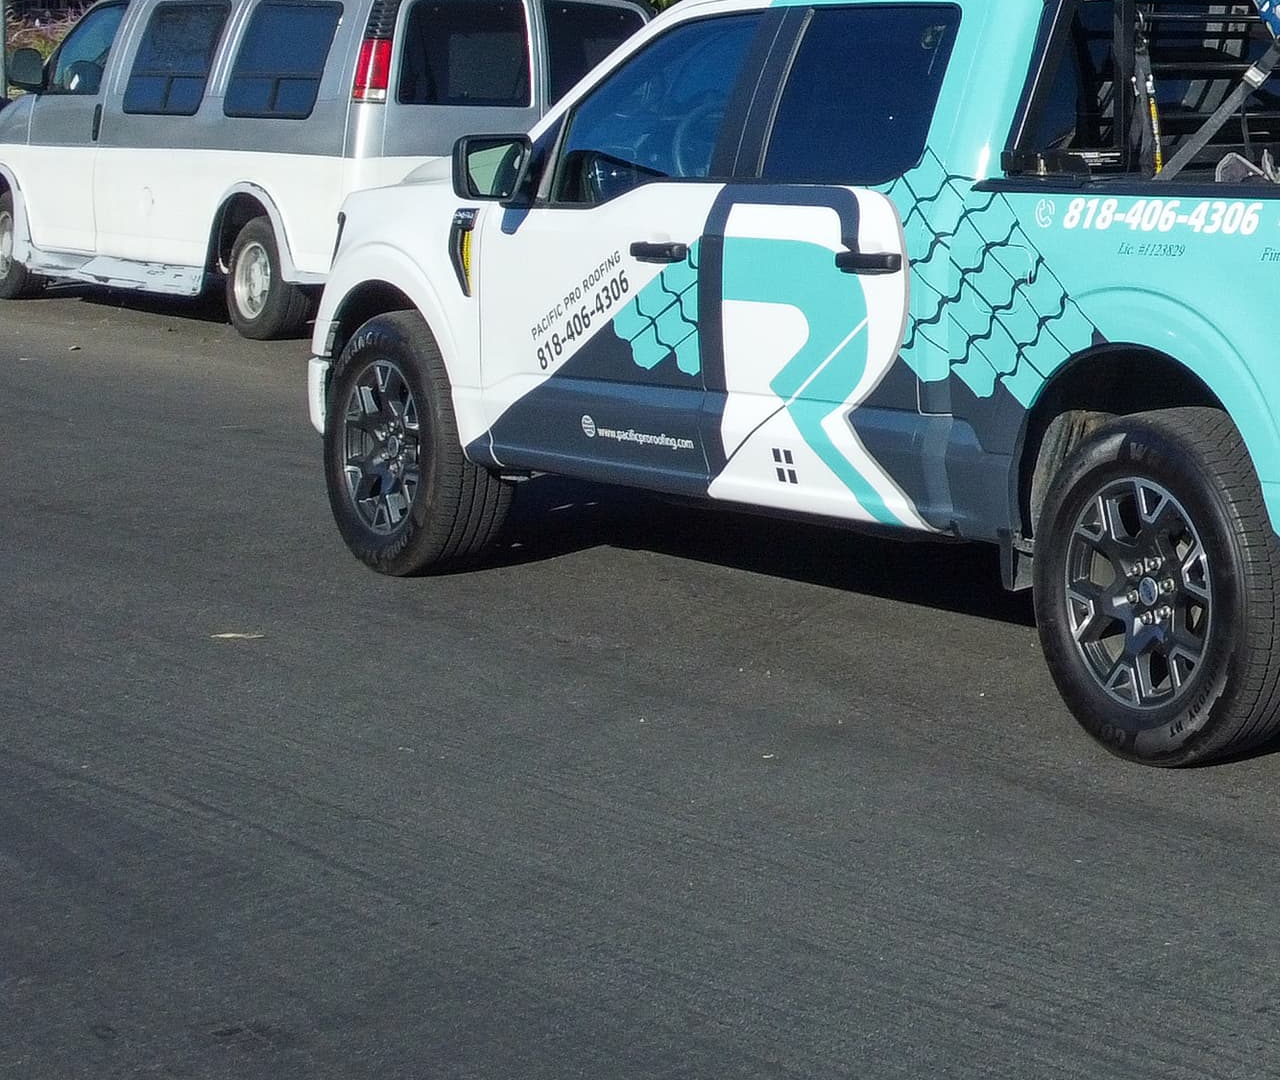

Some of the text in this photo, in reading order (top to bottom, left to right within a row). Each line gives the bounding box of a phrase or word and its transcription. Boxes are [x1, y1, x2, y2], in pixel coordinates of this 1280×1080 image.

[1063, 198, 1263, 235] 818-406-4306
[1117, 242, 1186, 257] Lic. #1123829
[531, 250, 621, 341] PACIFIC PRO ROOFING
[537, 269, 630, 370] 818-406-4306
[597, 427, 695, 450] www.pacificproroofing.com
